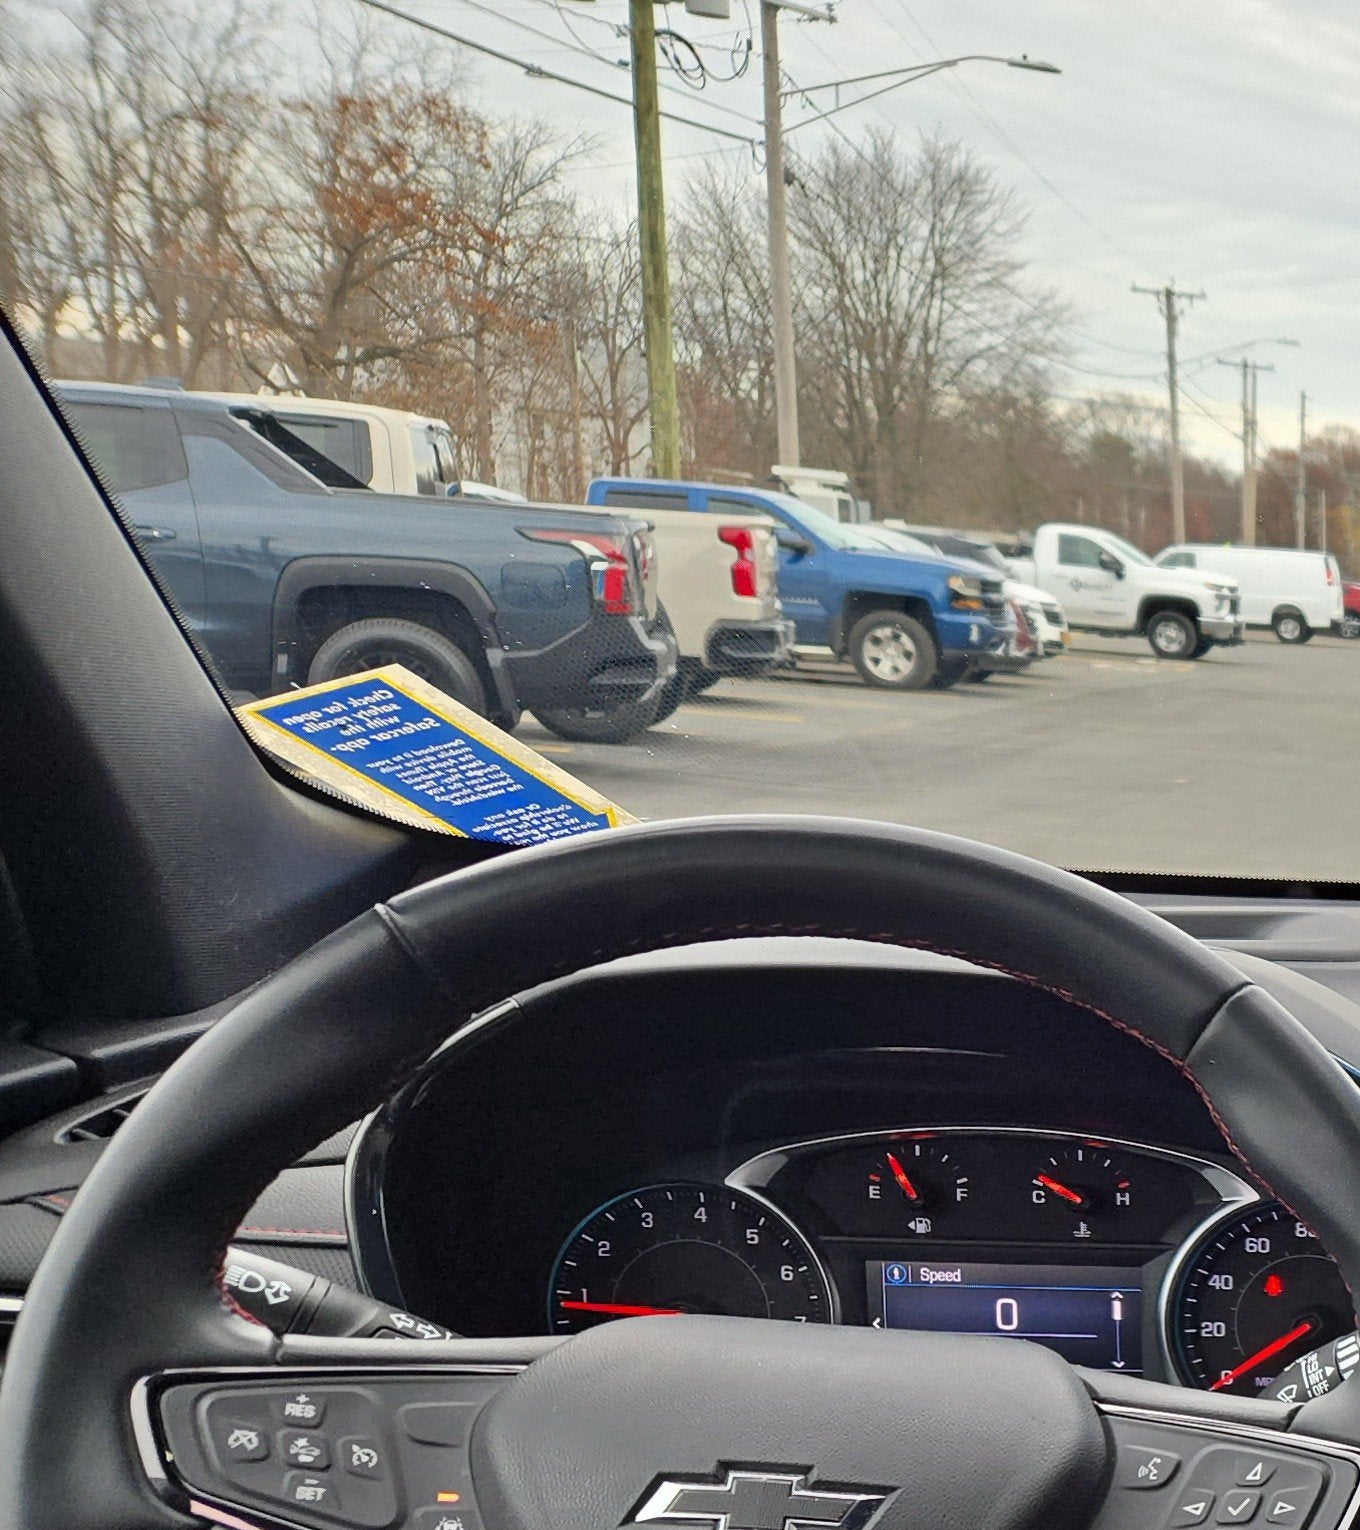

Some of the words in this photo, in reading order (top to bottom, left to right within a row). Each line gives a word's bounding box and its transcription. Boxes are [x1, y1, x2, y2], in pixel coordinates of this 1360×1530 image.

[869, 1186, 881, 1199] E
[957, 1189, 968, 1201] F
[1032, 1191, 1045, 1204] C
[1117, 1193, 1130, 1206] H
[641, 1212, 654, 1228] 3
[694, 1207, 707, 1223] 4
[746, 1229, 759, 1245] 5
[597, 1241, 611, 1257] 2
[1245, 1238, 1270, 1253] 60
[780, 1265, 793, 1281] 6
[919, 1267, 961, 1284] Speed
[1208, 1275, 1233, 1290] 40
[995, 1298, 1019, 1330] 0
[1201, 1322, 1226, 1337] 20
[1309, 1368, 1324, 1385] INT
[1312, 1379, 1330, 1397] OFF
